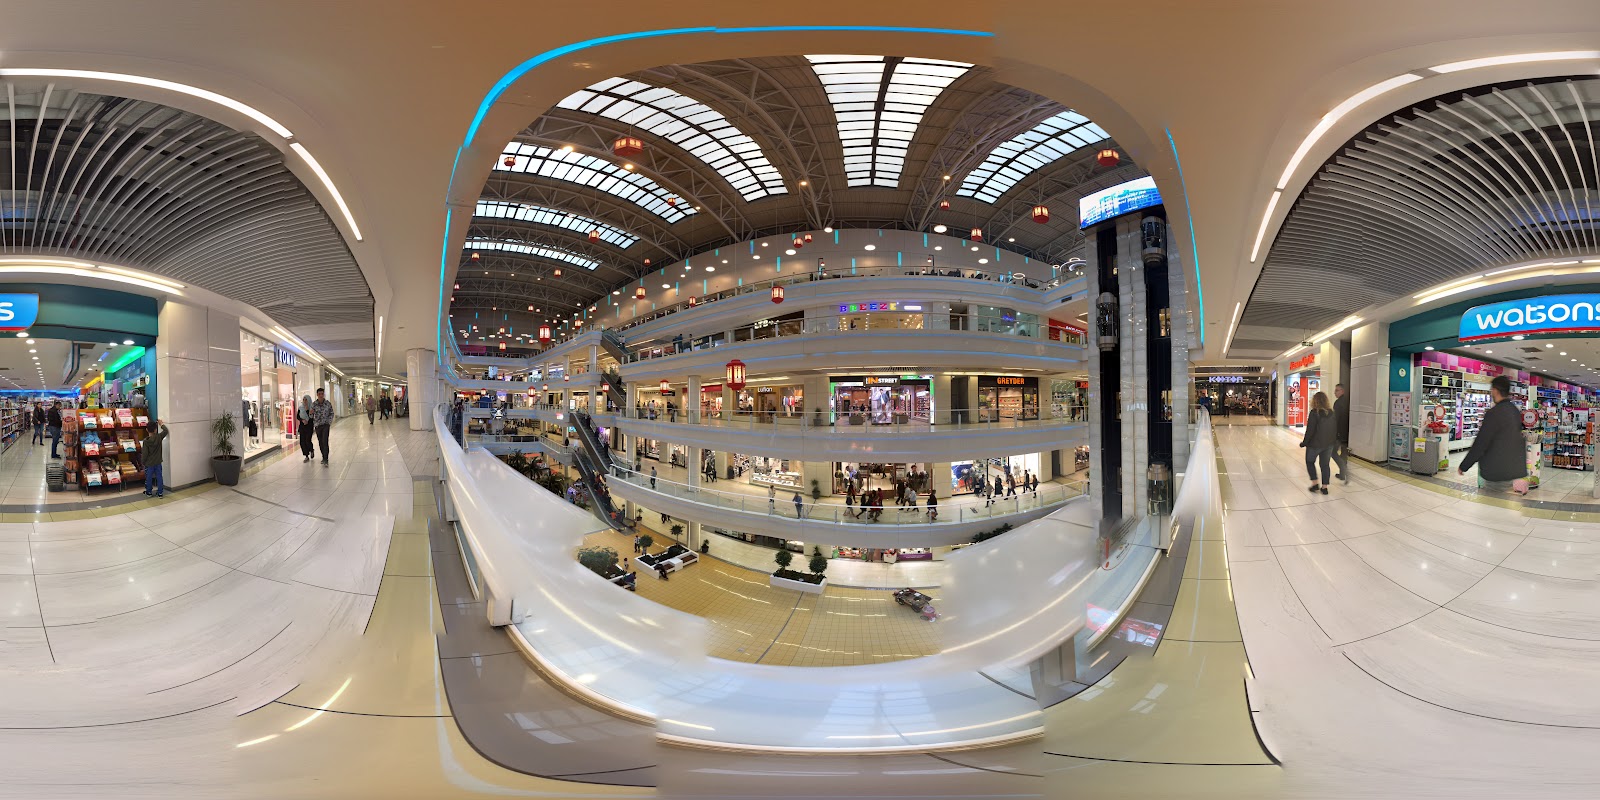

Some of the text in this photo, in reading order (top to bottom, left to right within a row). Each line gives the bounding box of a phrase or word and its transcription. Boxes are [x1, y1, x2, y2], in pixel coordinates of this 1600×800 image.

[840, 303, 897, 312] BREEZE
[1476, 302, 1600, 329] watson
[997, 377, 1024, 385] GREYDER
